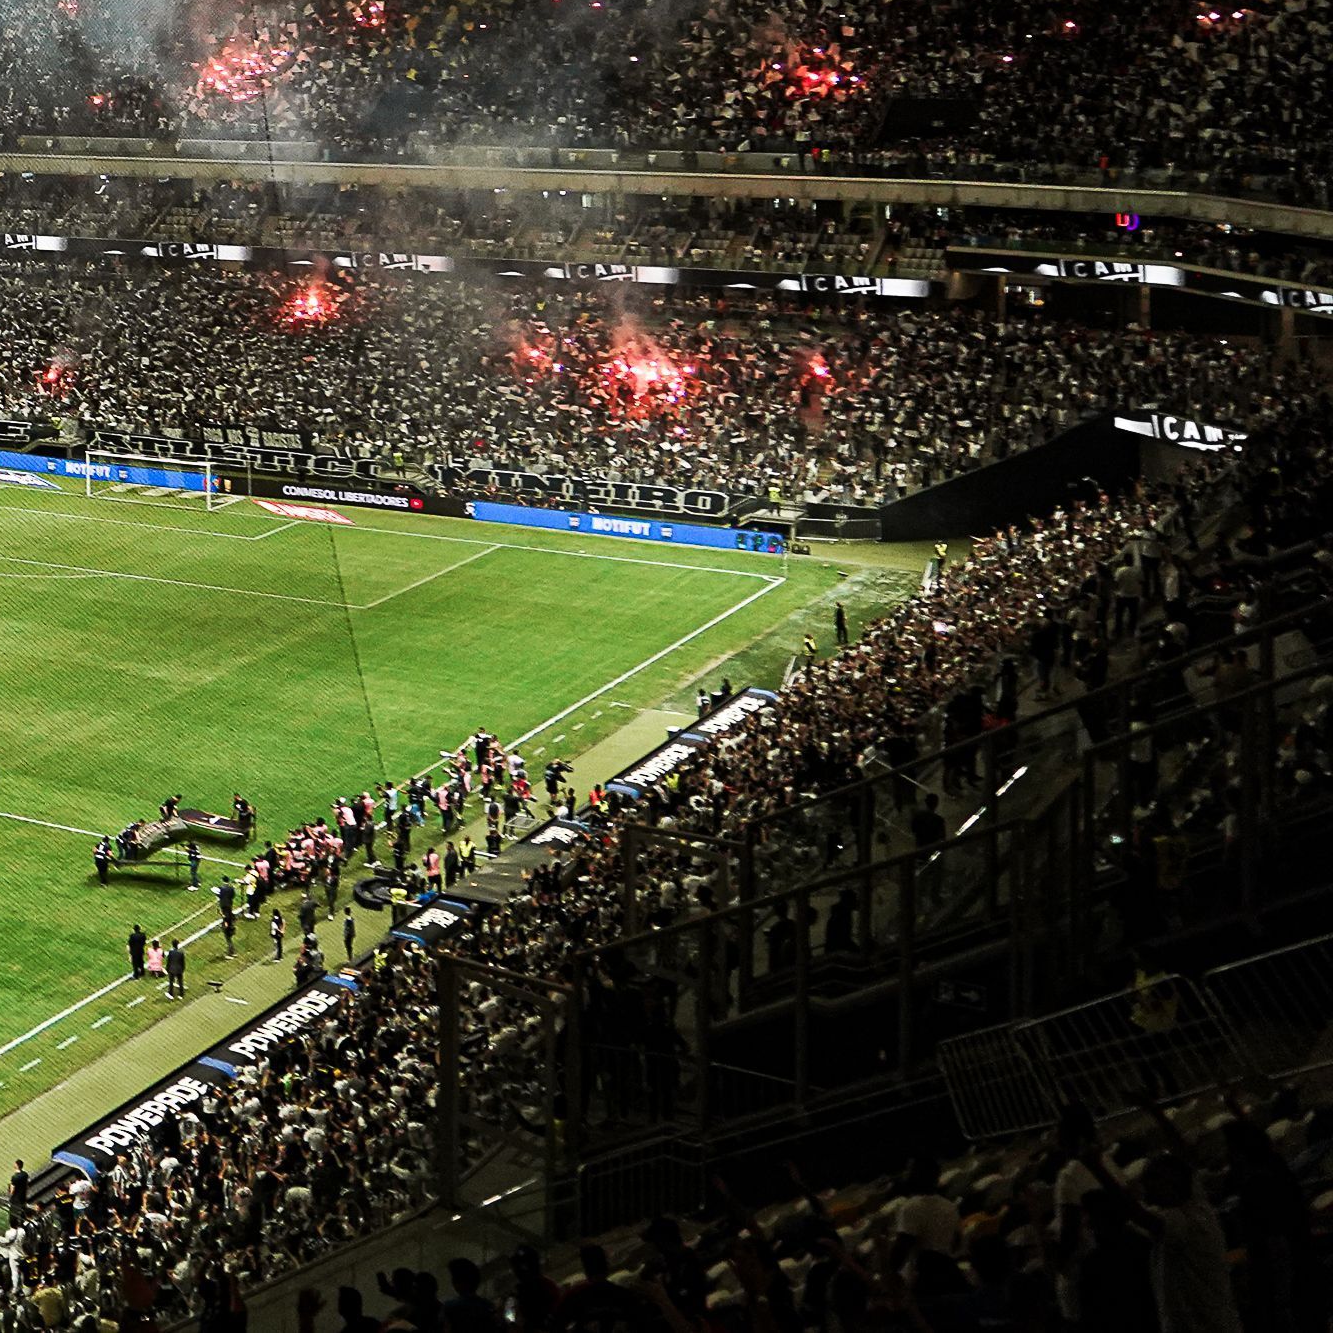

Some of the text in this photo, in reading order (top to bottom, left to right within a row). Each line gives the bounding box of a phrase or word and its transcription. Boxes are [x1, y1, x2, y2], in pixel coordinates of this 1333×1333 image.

[169, 243, 210, 257] CAM
[363, 253, 409, 267] CAM
[577, 264, 627, 279] CAM
[1074, 262, 1133, 277] CAM
[815, 276, 871, 292] CAM
[1163, 416, 1224, 441] CAM
[282, 486, 409, 508] CONMEBOL LIBERTADORES
[591, 517, 651, 536] NOTIFUT
[228, 989, 338, 1060] POWERADE
[85, 1076, 208, 1156] POWERADE
